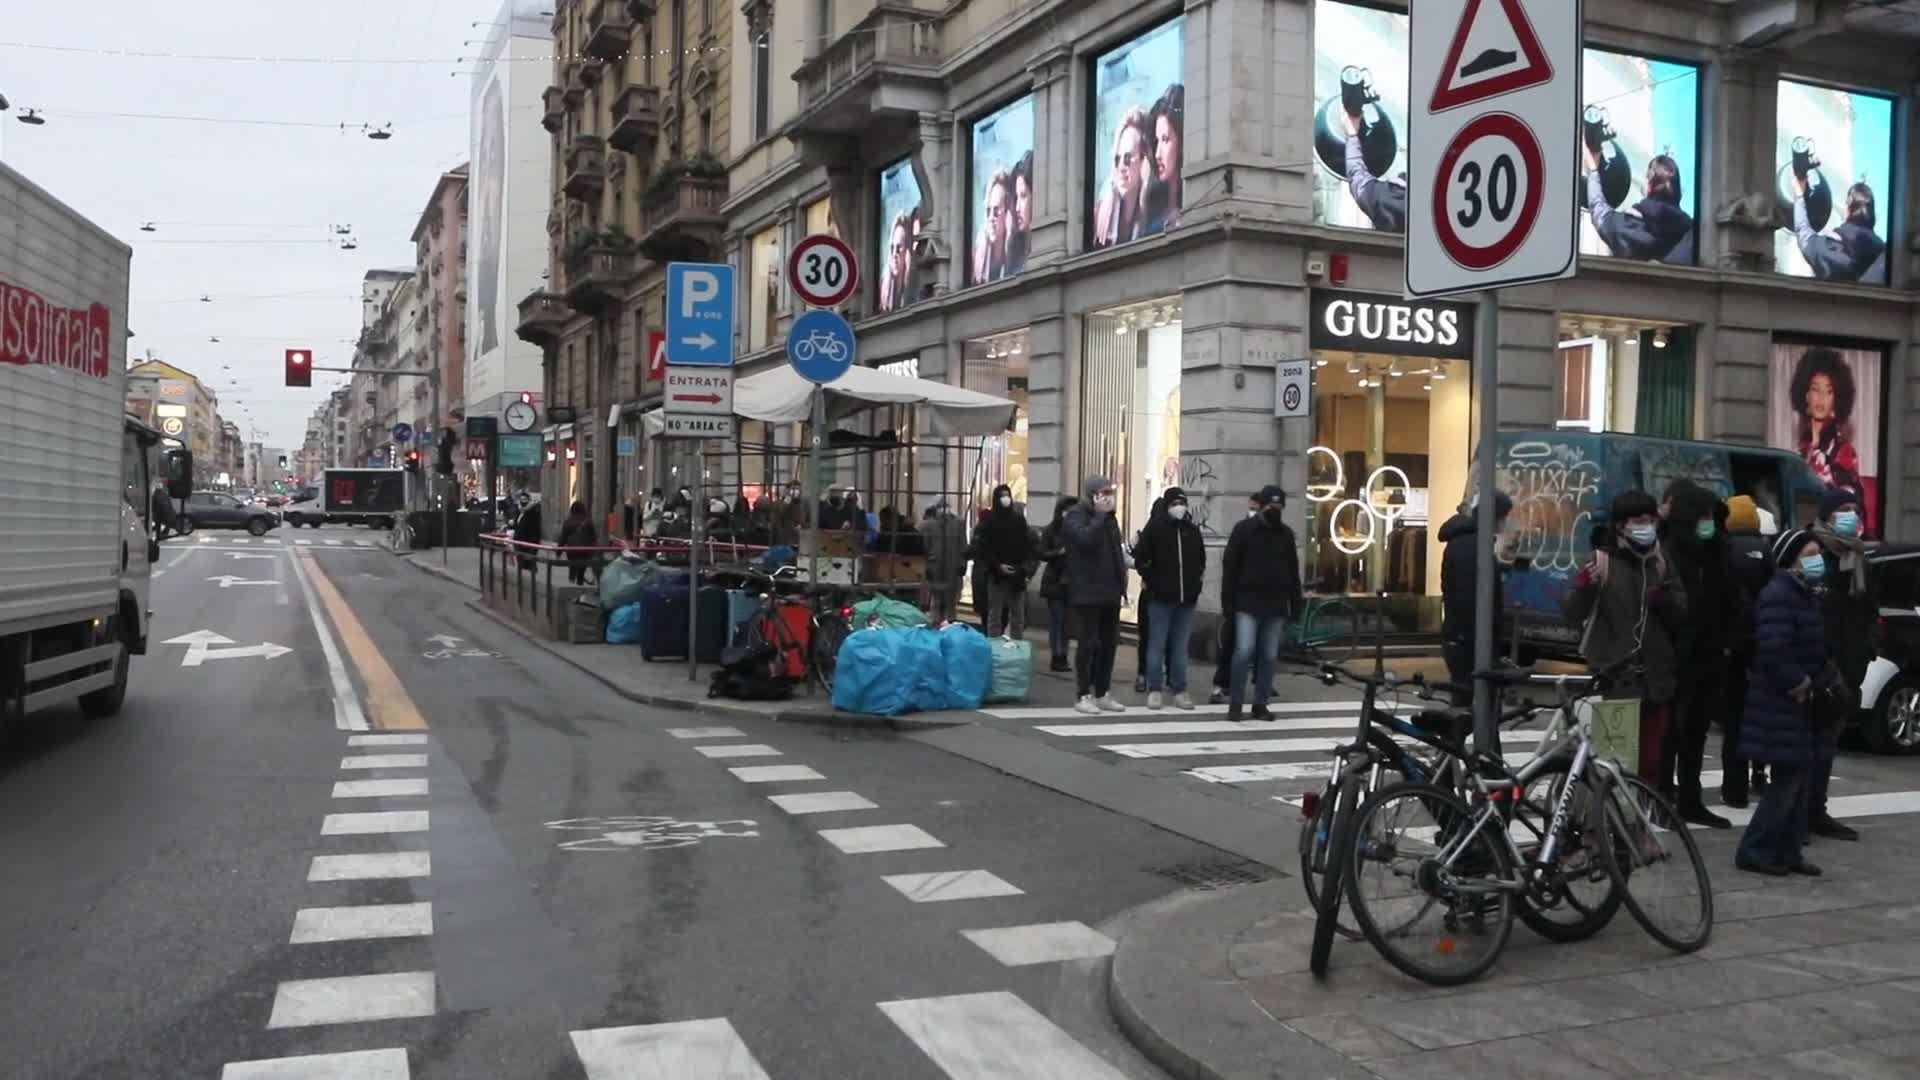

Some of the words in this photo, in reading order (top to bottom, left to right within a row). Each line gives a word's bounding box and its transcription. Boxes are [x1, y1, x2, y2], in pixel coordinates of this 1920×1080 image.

[1456, 153, 1517, 229] 30
[805, 253, 843, 287] 30
[682, 270, 719, 318] P
[1324, 299, 1459, 346] GUESS
[669, 376, 728, 387] ENTRATA
[1286, 390, 1299, 405] 30
[669, 420, 681, 431] NO
[685, 420, 715, 432] "AREA
[717, 420, 729, 432] C"
